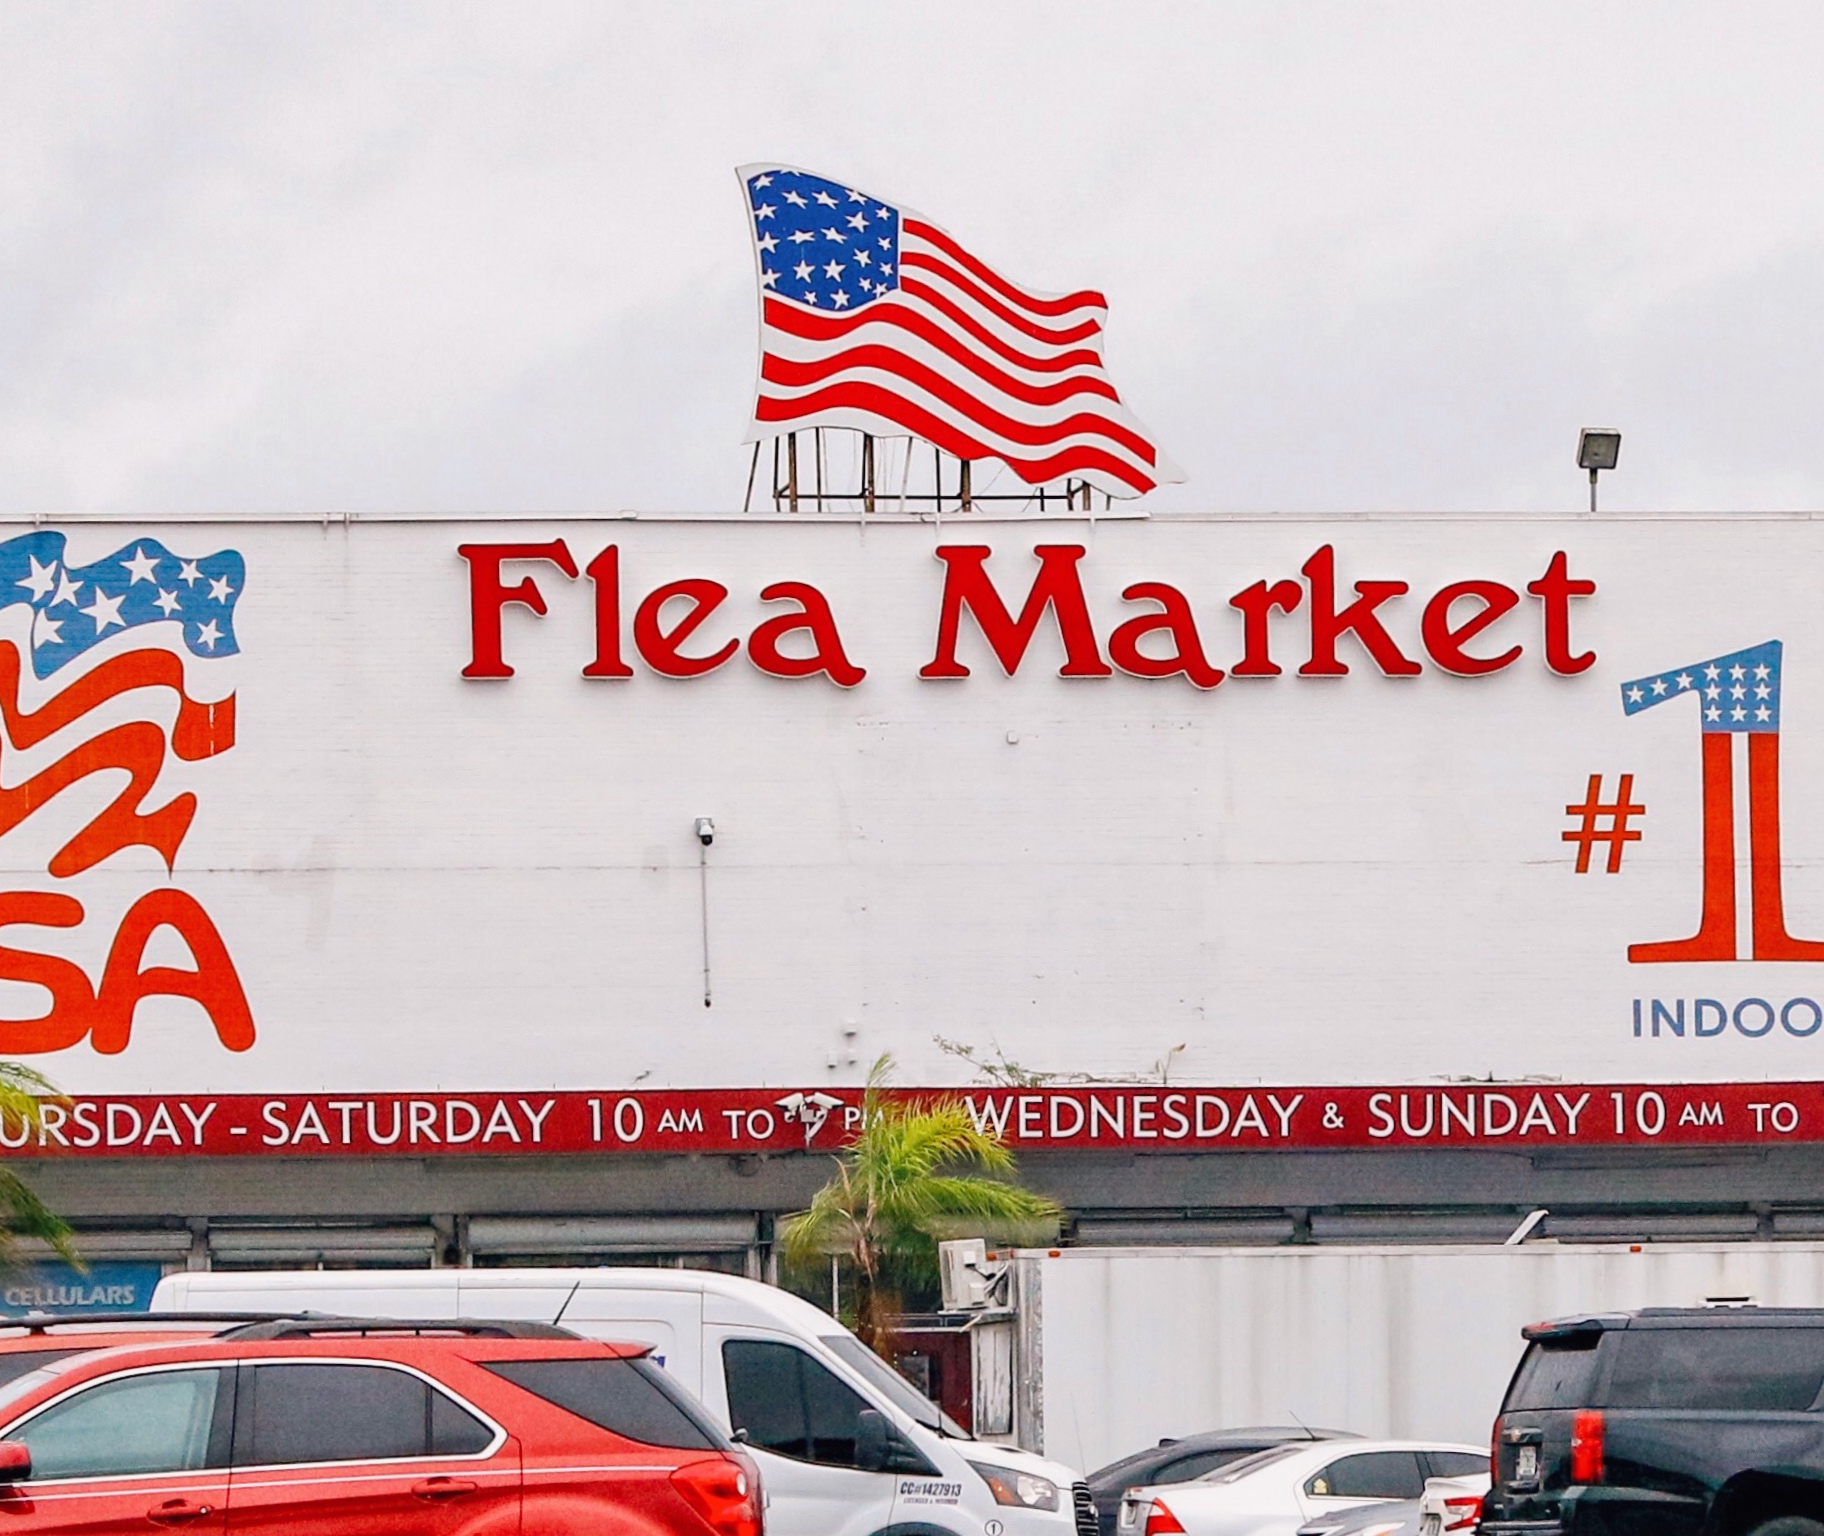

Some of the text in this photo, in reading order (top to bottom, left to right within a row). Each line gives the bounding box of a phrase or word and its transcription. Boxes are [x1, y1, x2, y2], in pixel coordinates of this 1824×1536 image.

[457, 538, 1597, 690] Flea Market
[261, 1099, 555, 1145] SATURDAY
[587, 1098, 644, 1143] 10
[657, 1108, 704, 1133] AM
[722, 1109, 775, 1141] TO
[964, 1094, 1303, 1140] WEDNESDAY
[1322, 1101, 1345, 1130] &
[1368, 1092, 1592, 1138] SUNDAY
[1609, 1090, 1666, 1136] 10
[1678, 1102, 1724, 1127] AM
[1747, 1102, 1799, 1133] TO
[4, 1284, 135, 1307] CELLULARS
